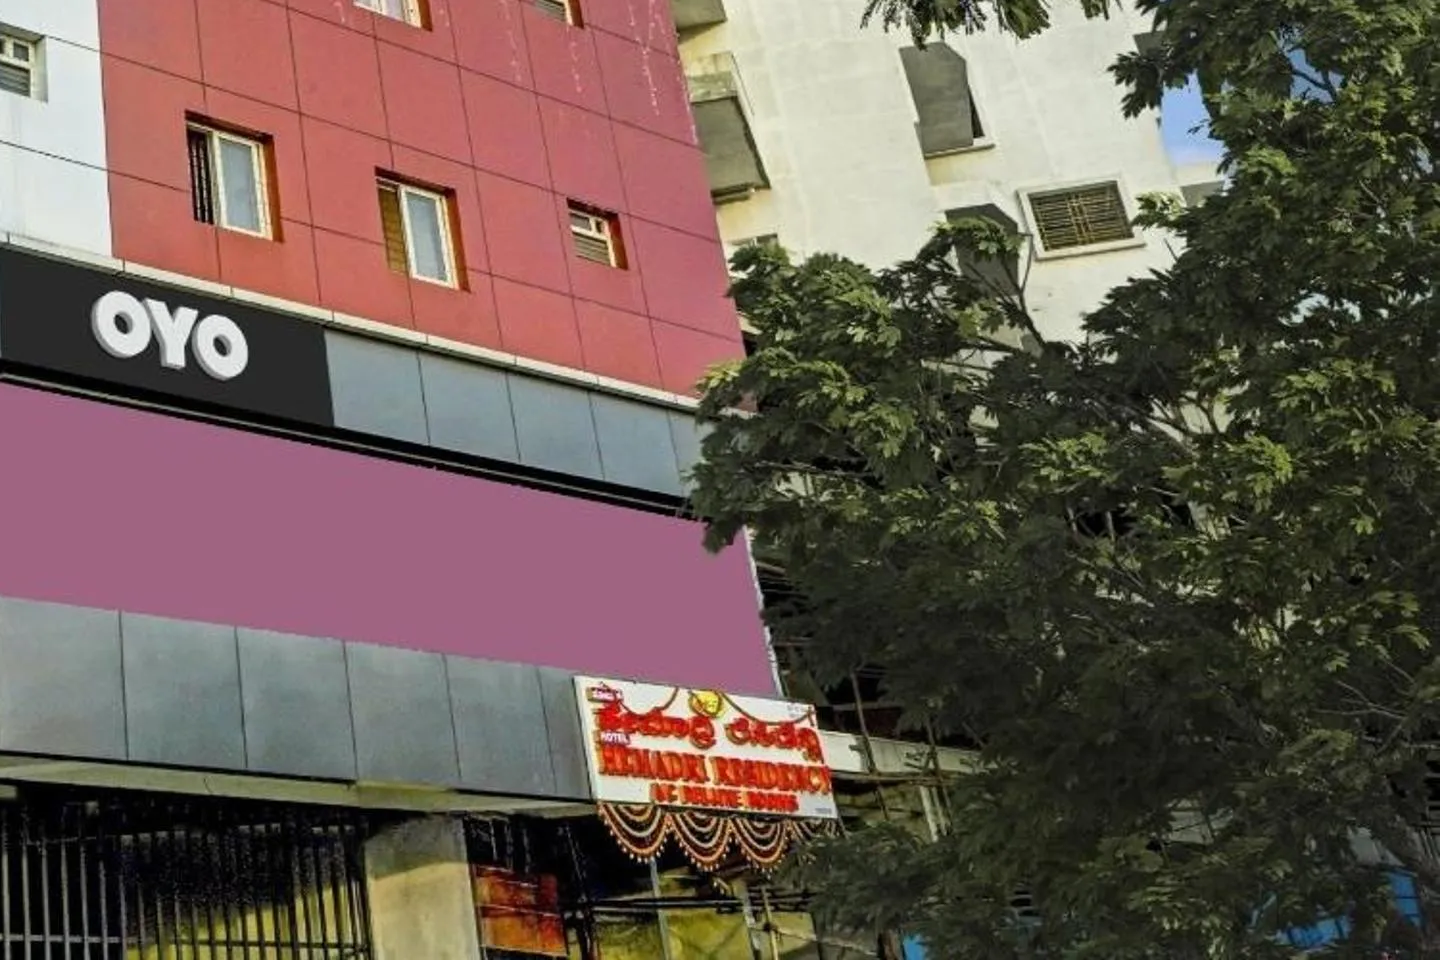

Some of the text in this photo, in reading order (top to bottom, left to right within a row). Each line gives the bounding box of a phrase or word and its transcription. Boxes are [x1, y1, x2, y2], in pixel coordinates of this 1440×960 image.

[91, 290, 249, 381] OYO
[710, 756, 832, 794] RESIDENCY
[743, 790, 799, 813] ROOMS
